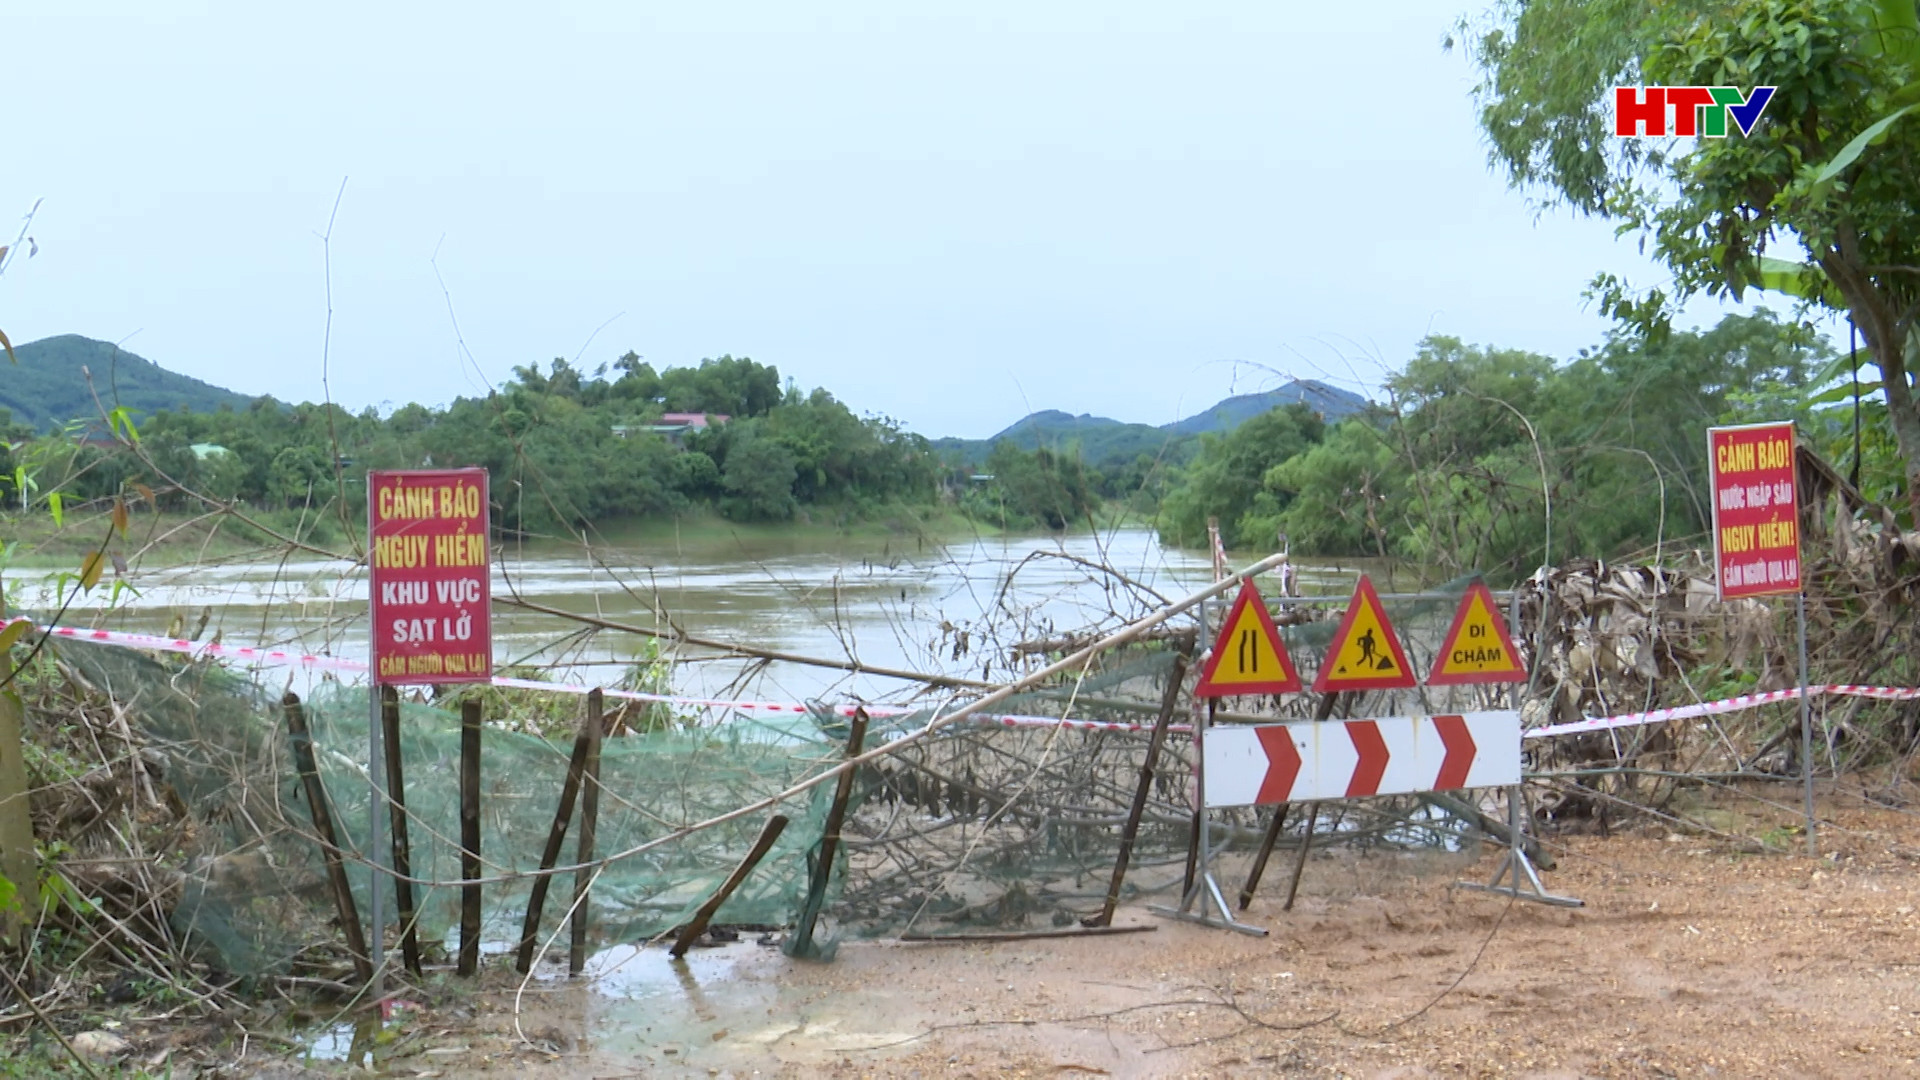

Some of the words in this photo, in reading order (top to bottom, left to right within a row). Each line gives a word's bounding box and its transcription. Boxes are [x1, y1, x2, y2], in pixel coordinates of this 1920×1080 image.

[1718, 435, 1755, 474] CẢNH
[1758, 436, 1790, 470] BÁO!
[379, 477, 434, 520] CẢNH
[440, 479, 480, 519] BÁO
[375, 534, 429, 569] NGUY
[435, 521, 486, 567] HIỂM
[1722, 525, 1755, 553] NGUY
[1758, 511, 1794, 550] HIỂM!
[382, 581, 429, 606] KHU
[436, 578, 480, 608] VỰC
[393, 618, 437, 647] SẠT
[443, 609, 472, 640] LỞ
[380, 650, 405, 676] CẤM
[445, 653, 467, 674] QUA
[469, 653, 486, 676] LẠI
[1453, 646, 1501, 668] CHẬM
